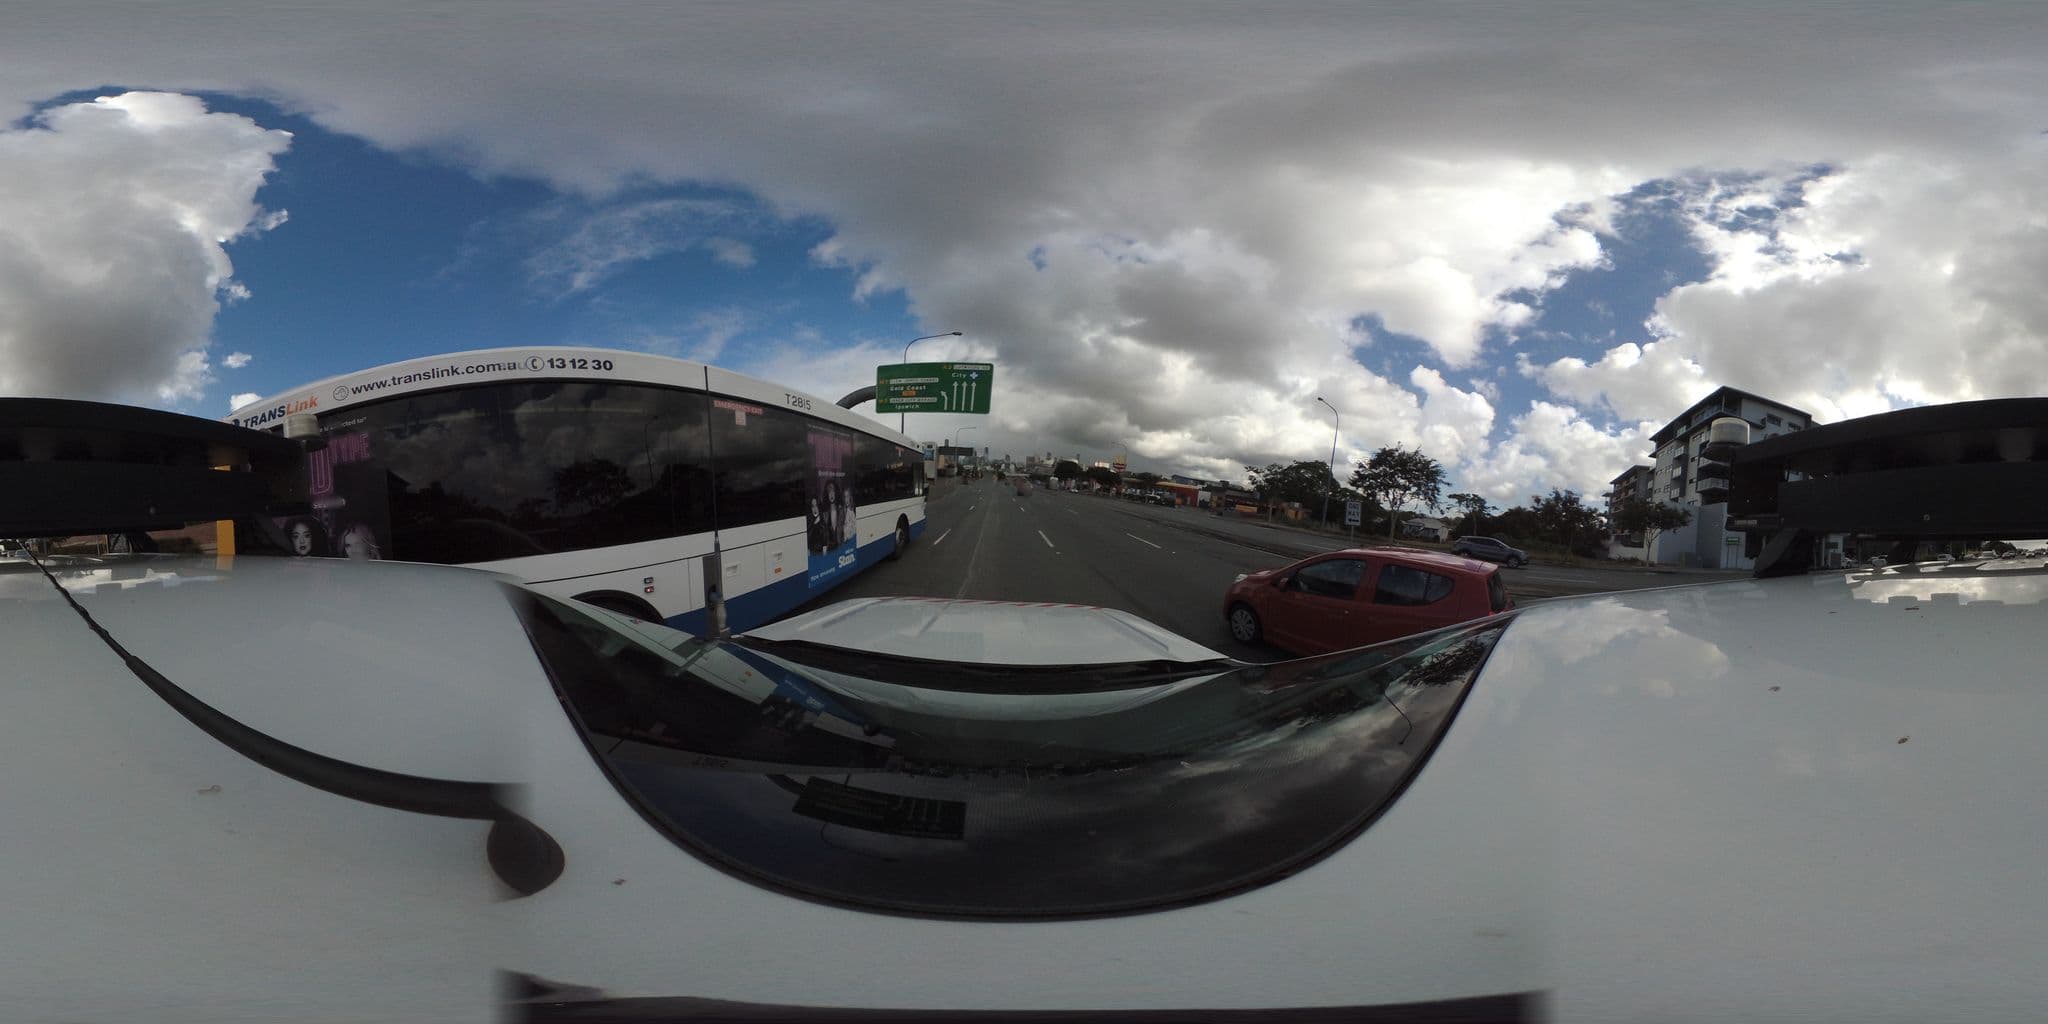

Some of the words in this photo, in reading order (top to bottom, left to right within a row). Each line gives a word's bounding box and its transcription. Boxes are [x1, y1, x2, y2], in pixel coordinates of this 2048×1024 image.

[547, 358, 567, 369] 13
[569, 359, 588, 370] 12
[592, 360, 614, 371] 30
[785, 393, 811, 411] T2815
[243, 396, 319, 428] TRANSLink
